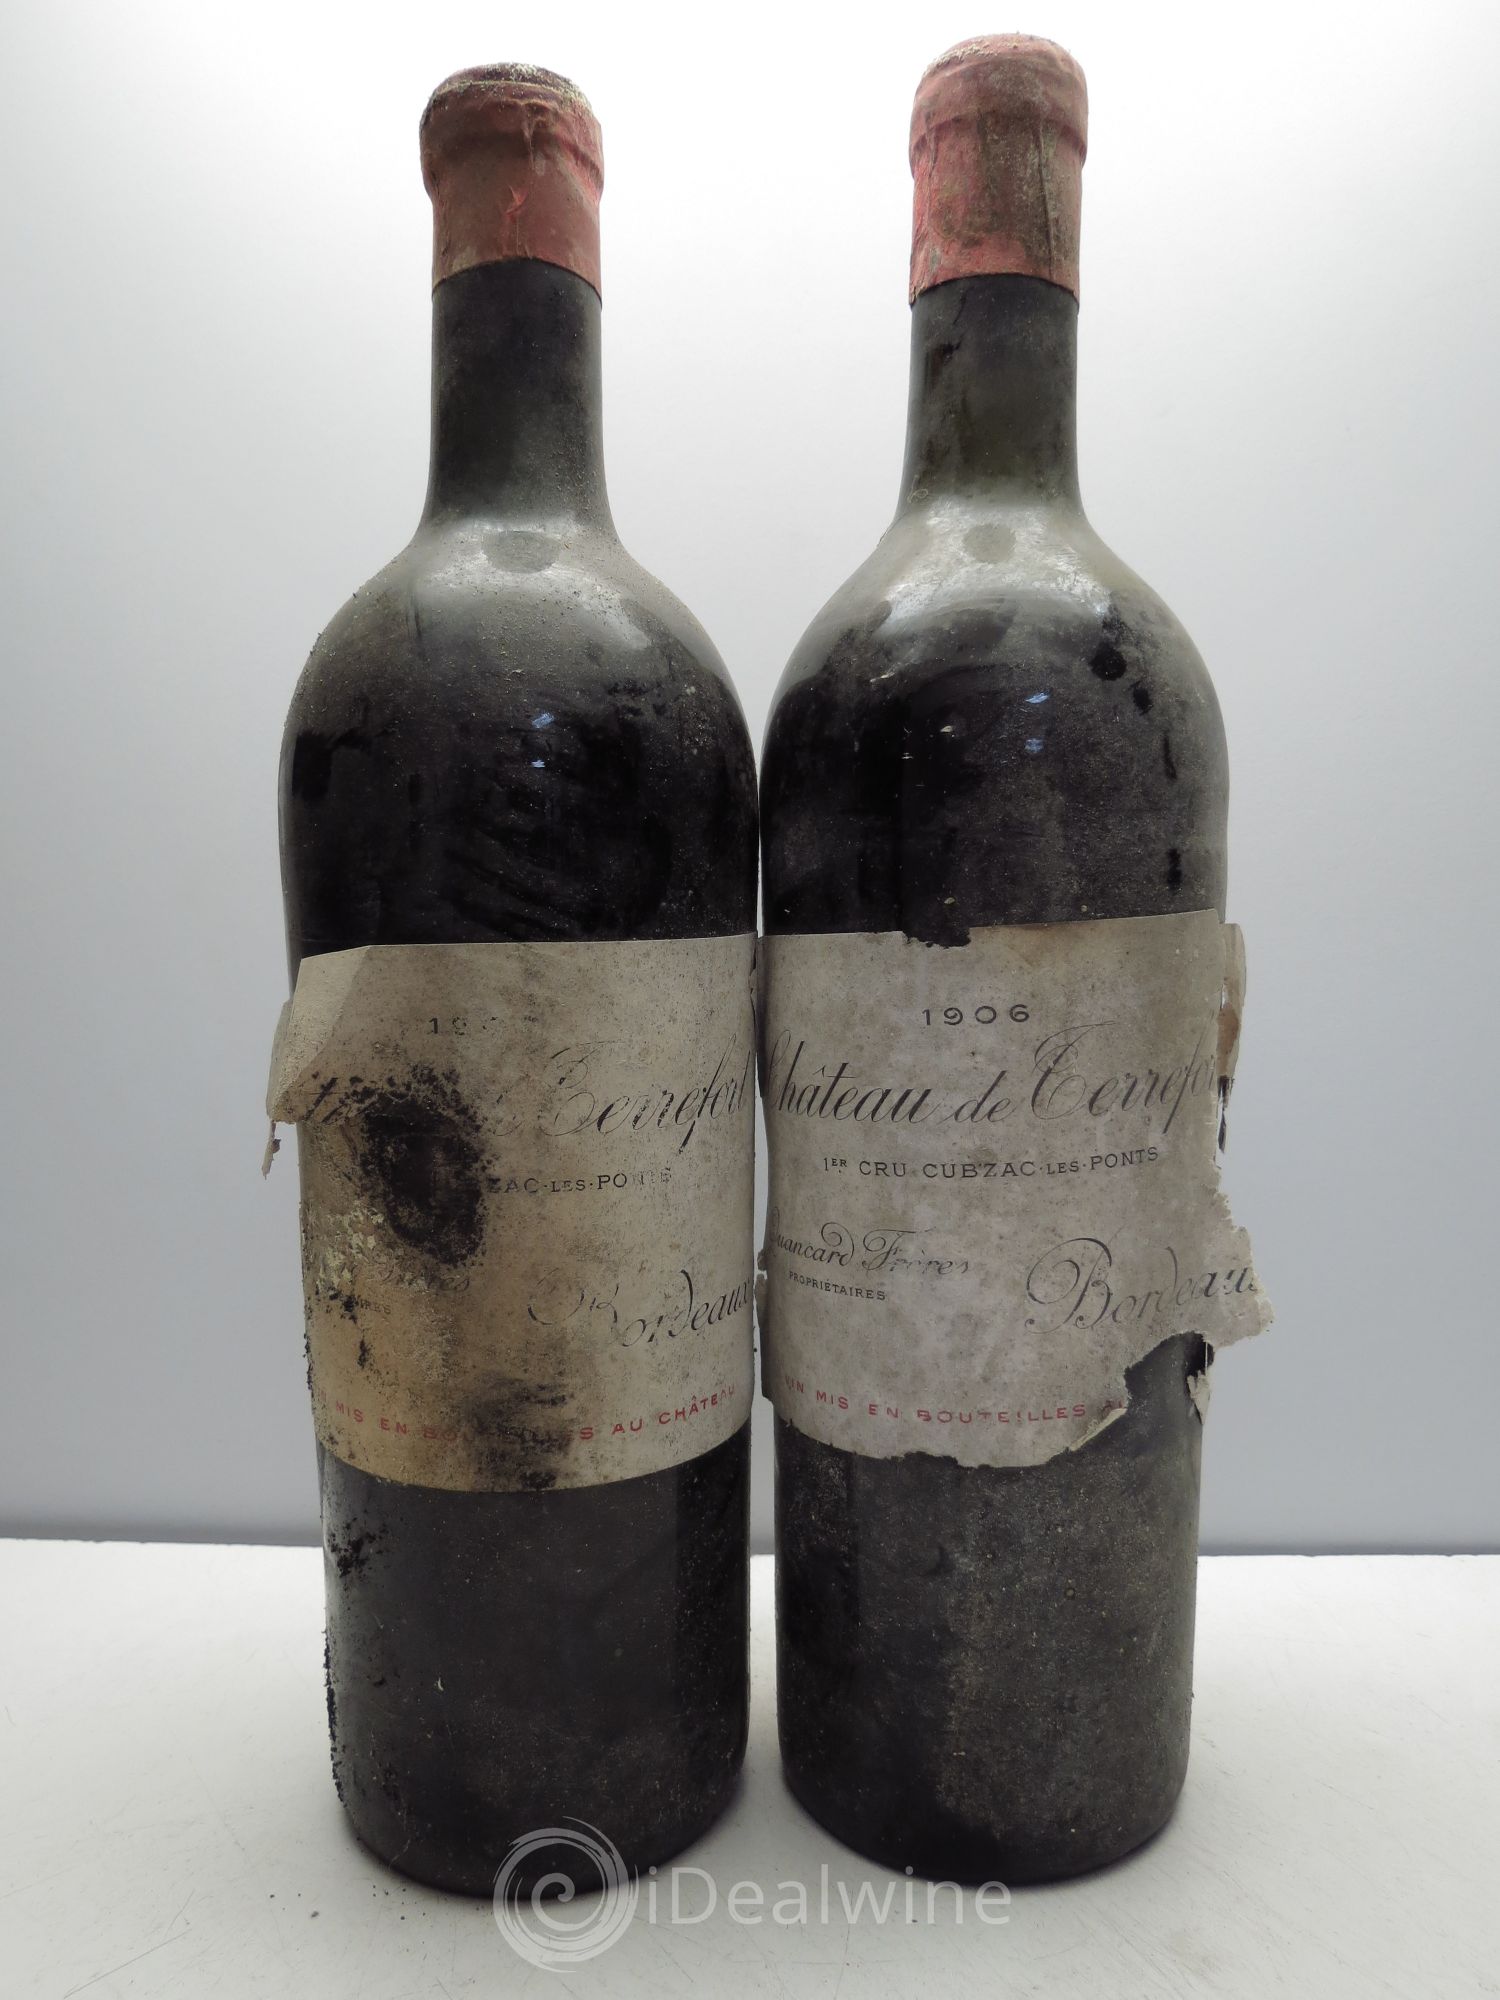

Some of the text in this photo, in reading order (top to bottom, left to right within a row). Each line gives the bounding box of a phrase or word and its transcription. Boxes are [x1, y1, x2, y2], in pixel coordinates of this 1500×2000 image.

[922, 1003, 1031, 1026] 1906
[767, 1018, 1216, 1135] Château de Terrefor
[858, 1160, 907, 1177] CRU
[788, 1270, 886, 1301] PROPRIÉTAIRES
[1023, 1226, 1258, 1335] Bordeau
[335, 1400, 364, 1423] MIS
[379, 1416, 408, 1436] EN
[611, 1417, 644, 1436] AU
[658, 1385, 736, 1426] CHÂTEAU
[784, 1375, 805, 1394] VIN
[816, 1389, 849, 1410] MIS
[867, 1403, 899, 1419] EN
[916, 1403, 1086, 1424] BOUTEILLES
